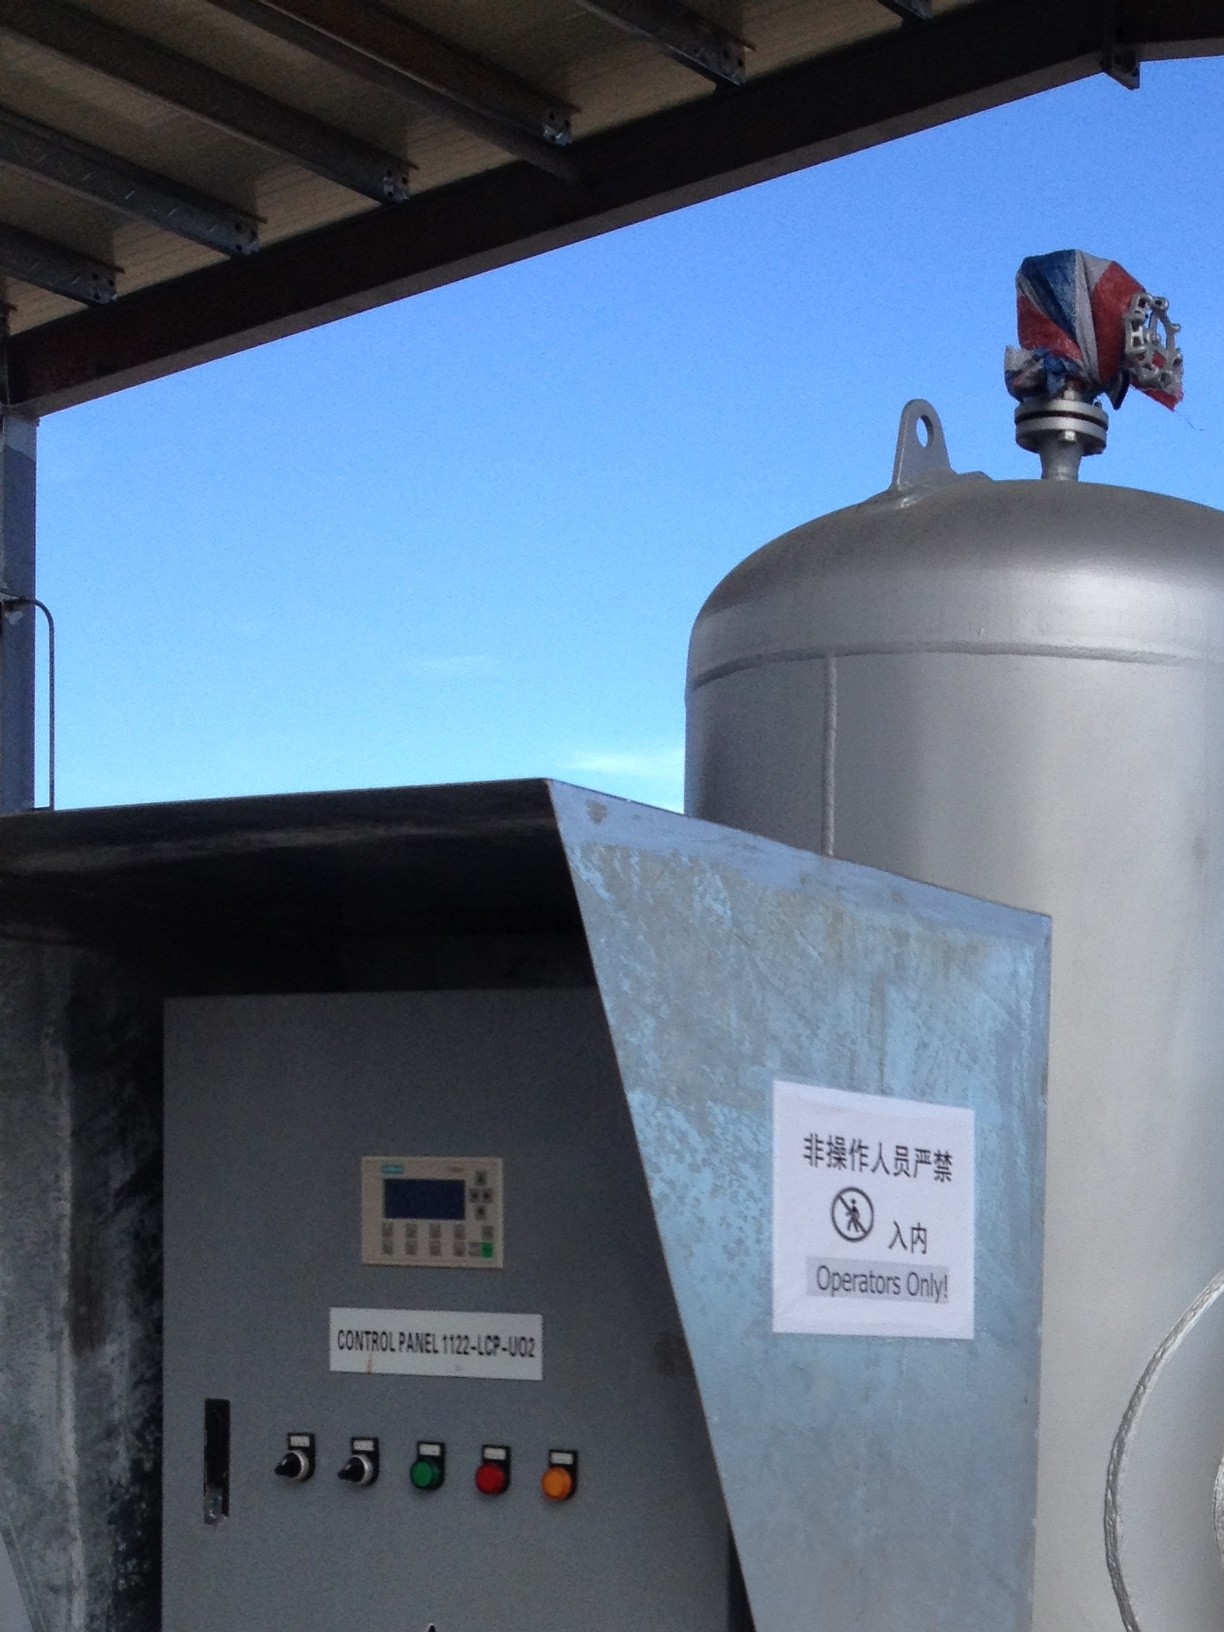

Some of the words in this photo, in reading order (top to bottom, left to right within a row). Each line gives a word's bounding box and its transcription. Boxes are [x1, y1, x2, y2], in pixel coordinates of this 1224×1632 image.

[803, 1132, 952, 1182] 非操作人员严禁
[888, 1220, 928, 1254] 入内
[816, 1265, 901, 1297] Operators
[907, 1270, 948, 1303] Only!
[337, 1329, 395, 1352] CONTROL
[399, 1331, 439, 1354] PANEL
